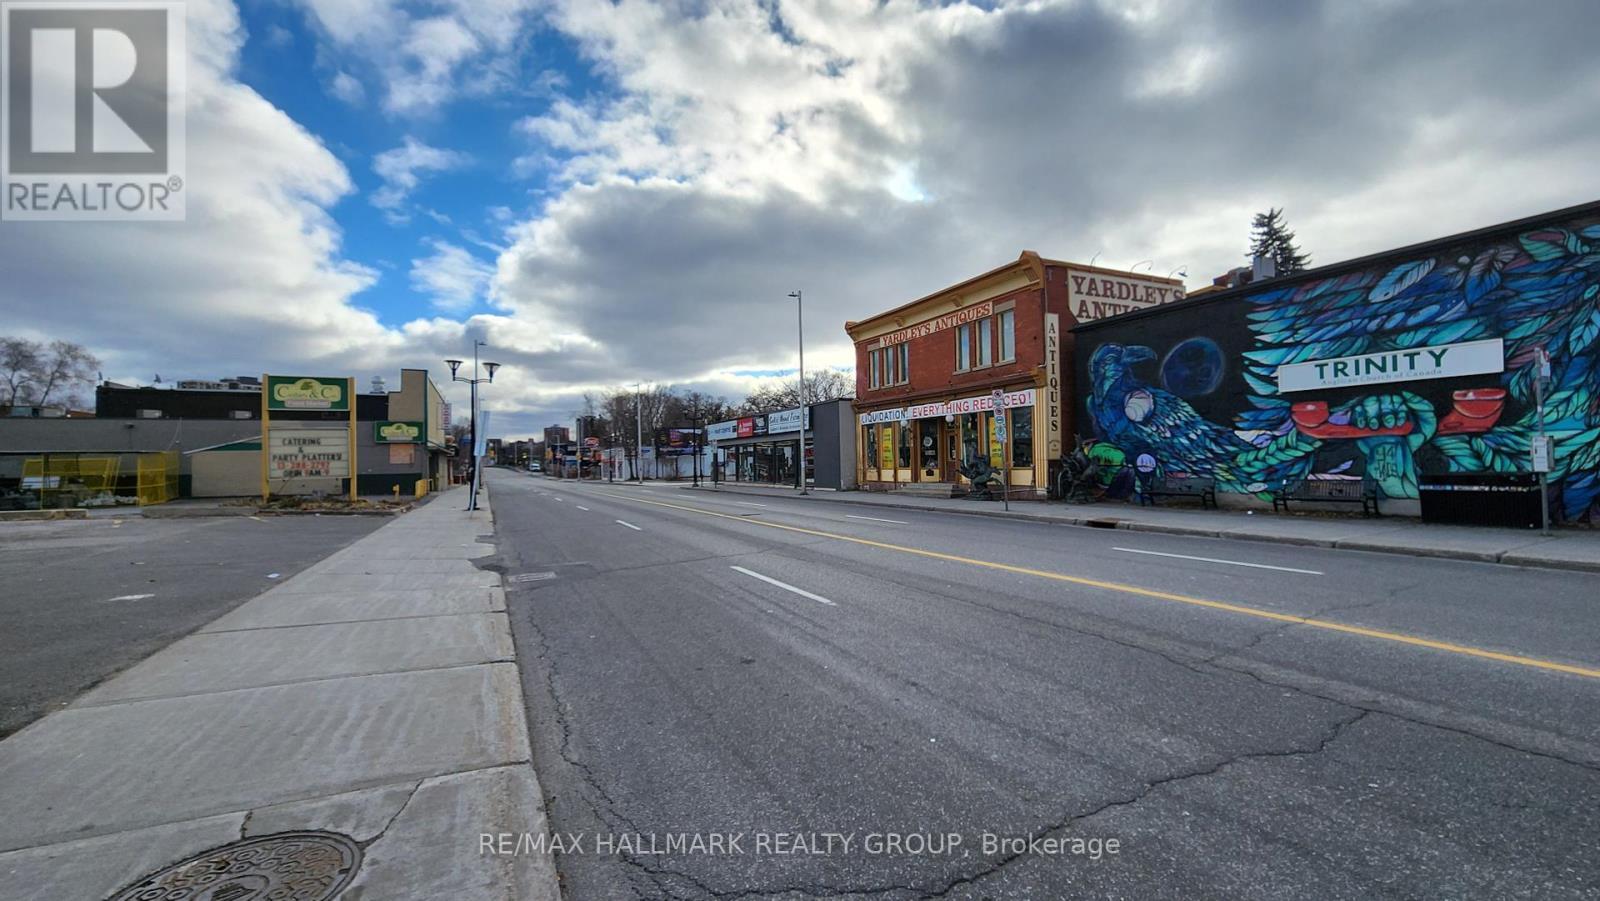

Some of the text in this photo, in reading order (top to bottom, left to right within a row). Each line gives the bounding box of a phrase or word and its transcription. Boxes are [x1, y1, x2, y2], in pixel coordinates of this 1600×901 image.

[1071, 275, 1184, 305] YARDLEY'S
[882, 303, 991, 347] YARDLEY'S ANTIQUES
[1048, 322, 1058, 432] ANTIQUES
[1314, 348, 1449, 379] TRINITY
[912, 400, 970, 417] EVERYTHING
[973, 394, 1032, 410] REDCED!
[272, 453, 298, 461] PARTY
[282, 438, 321, 446] CATERING
